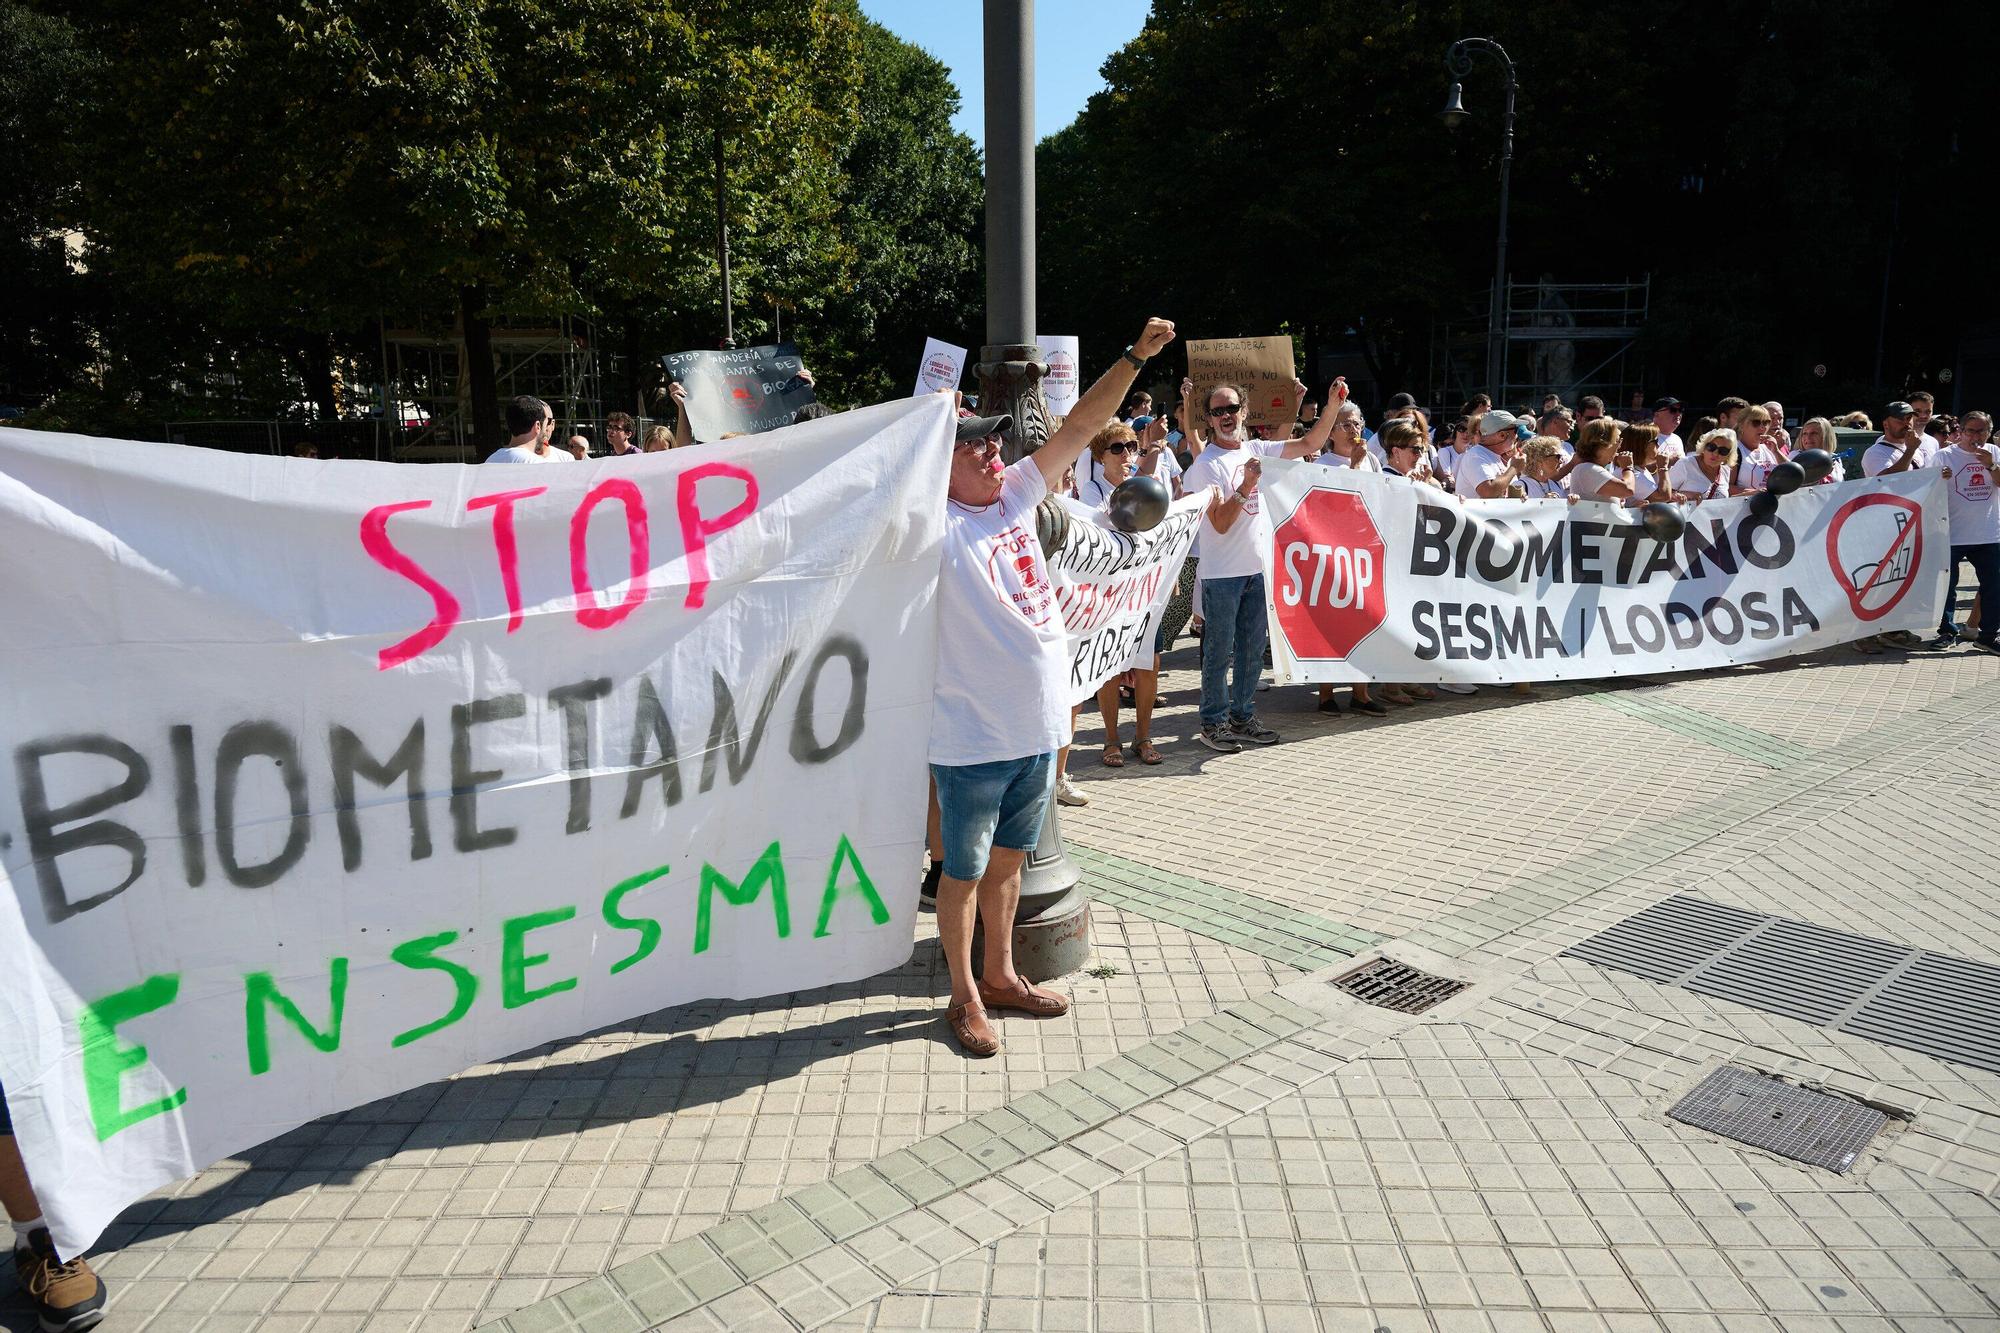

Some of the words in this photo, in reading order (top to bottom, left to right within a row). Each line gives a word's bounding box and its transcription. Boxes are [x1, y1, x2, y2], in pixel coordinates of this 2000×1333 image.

[670, 352, 700, 366] STOP
[775, 360, 796, 371] DE
[1262, 372, 1278, 380] NO
[749, 415, 789, 431] MUNDO
[361, 463, 760, 671] STOP
[1283, 541, 1373, 610] STOP
[1410, 503, 1796, 585] BIOMETANO
[1412, 600, 1569, 661] SESMA
[1597, 587, 1821, 656] LODOSA
[15, 635, 870, 925] BIOMETANO
